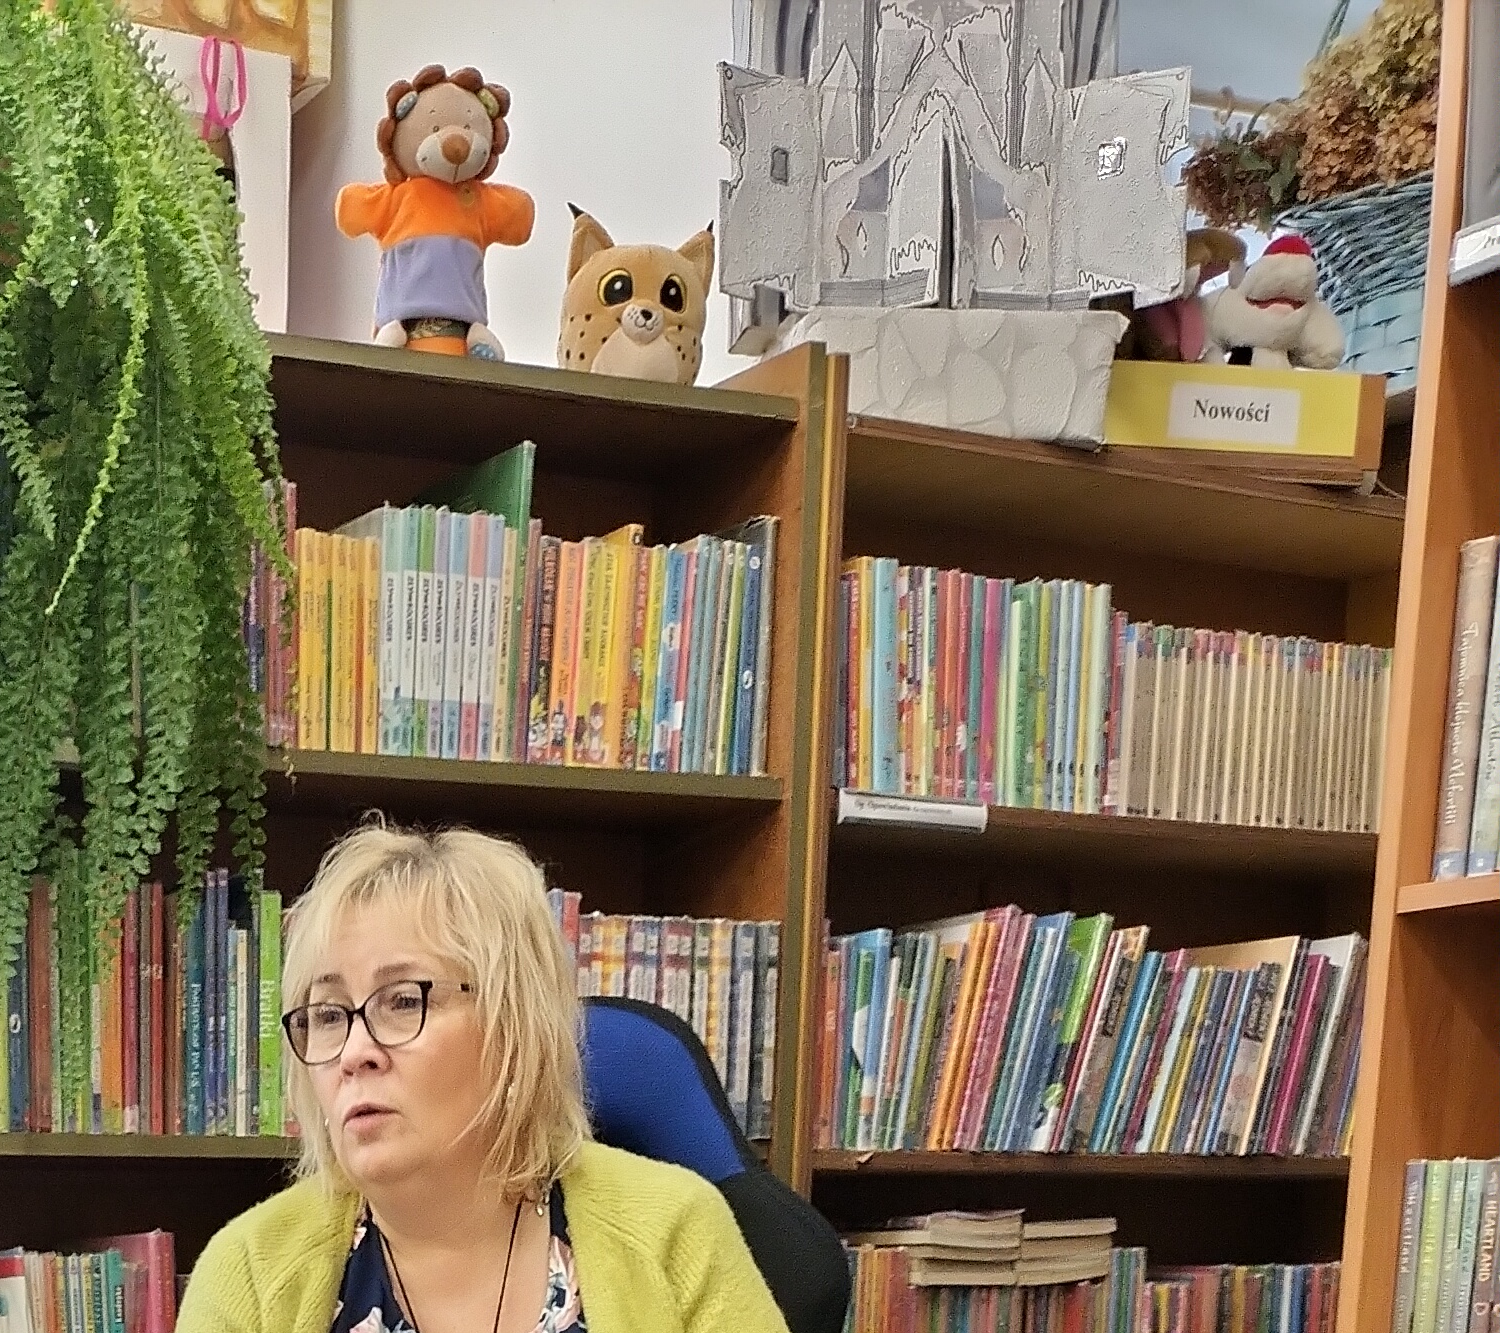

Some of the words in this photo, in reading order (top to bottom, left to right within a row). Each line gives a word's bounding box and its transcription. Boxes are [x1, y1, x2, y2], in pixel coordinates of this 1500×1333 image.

[1192, 398, 1271, 424] Nowości
[1456, 622, 1479, 697] Tajemnica
[1443, 759, 1465, 826] Nefertiti
[260, 979, 281, 1038] Bratki
[1479, 1200, 1498, 1282] HEARTLAND
